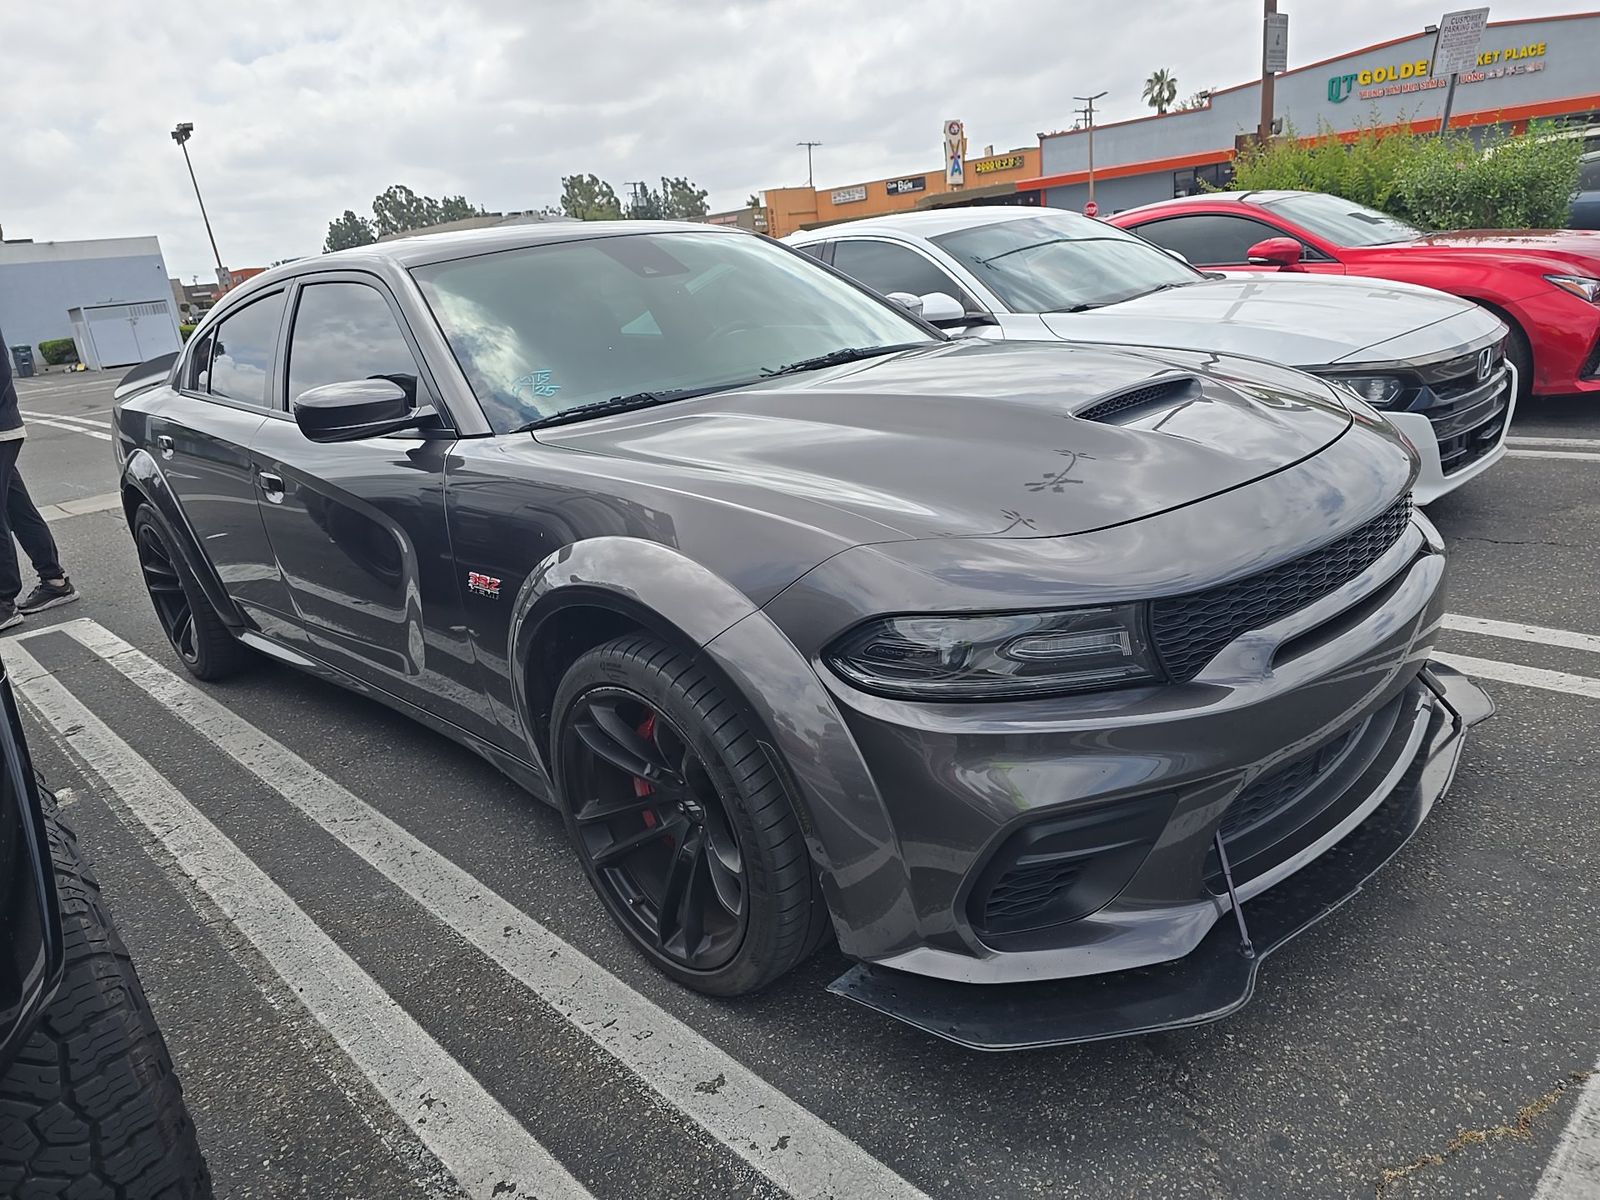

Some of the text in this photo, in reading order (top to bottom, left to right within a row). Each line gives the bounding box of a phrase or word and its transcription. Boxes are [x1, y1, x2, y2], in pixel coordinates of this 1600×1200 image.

[1444, 24, 1470, 33] PARKING
[1358, 60, 1429, 86] GOLDE
[1476, 49, 1501, 66] KET
[1503, 42, 1547, 62] PLACE
